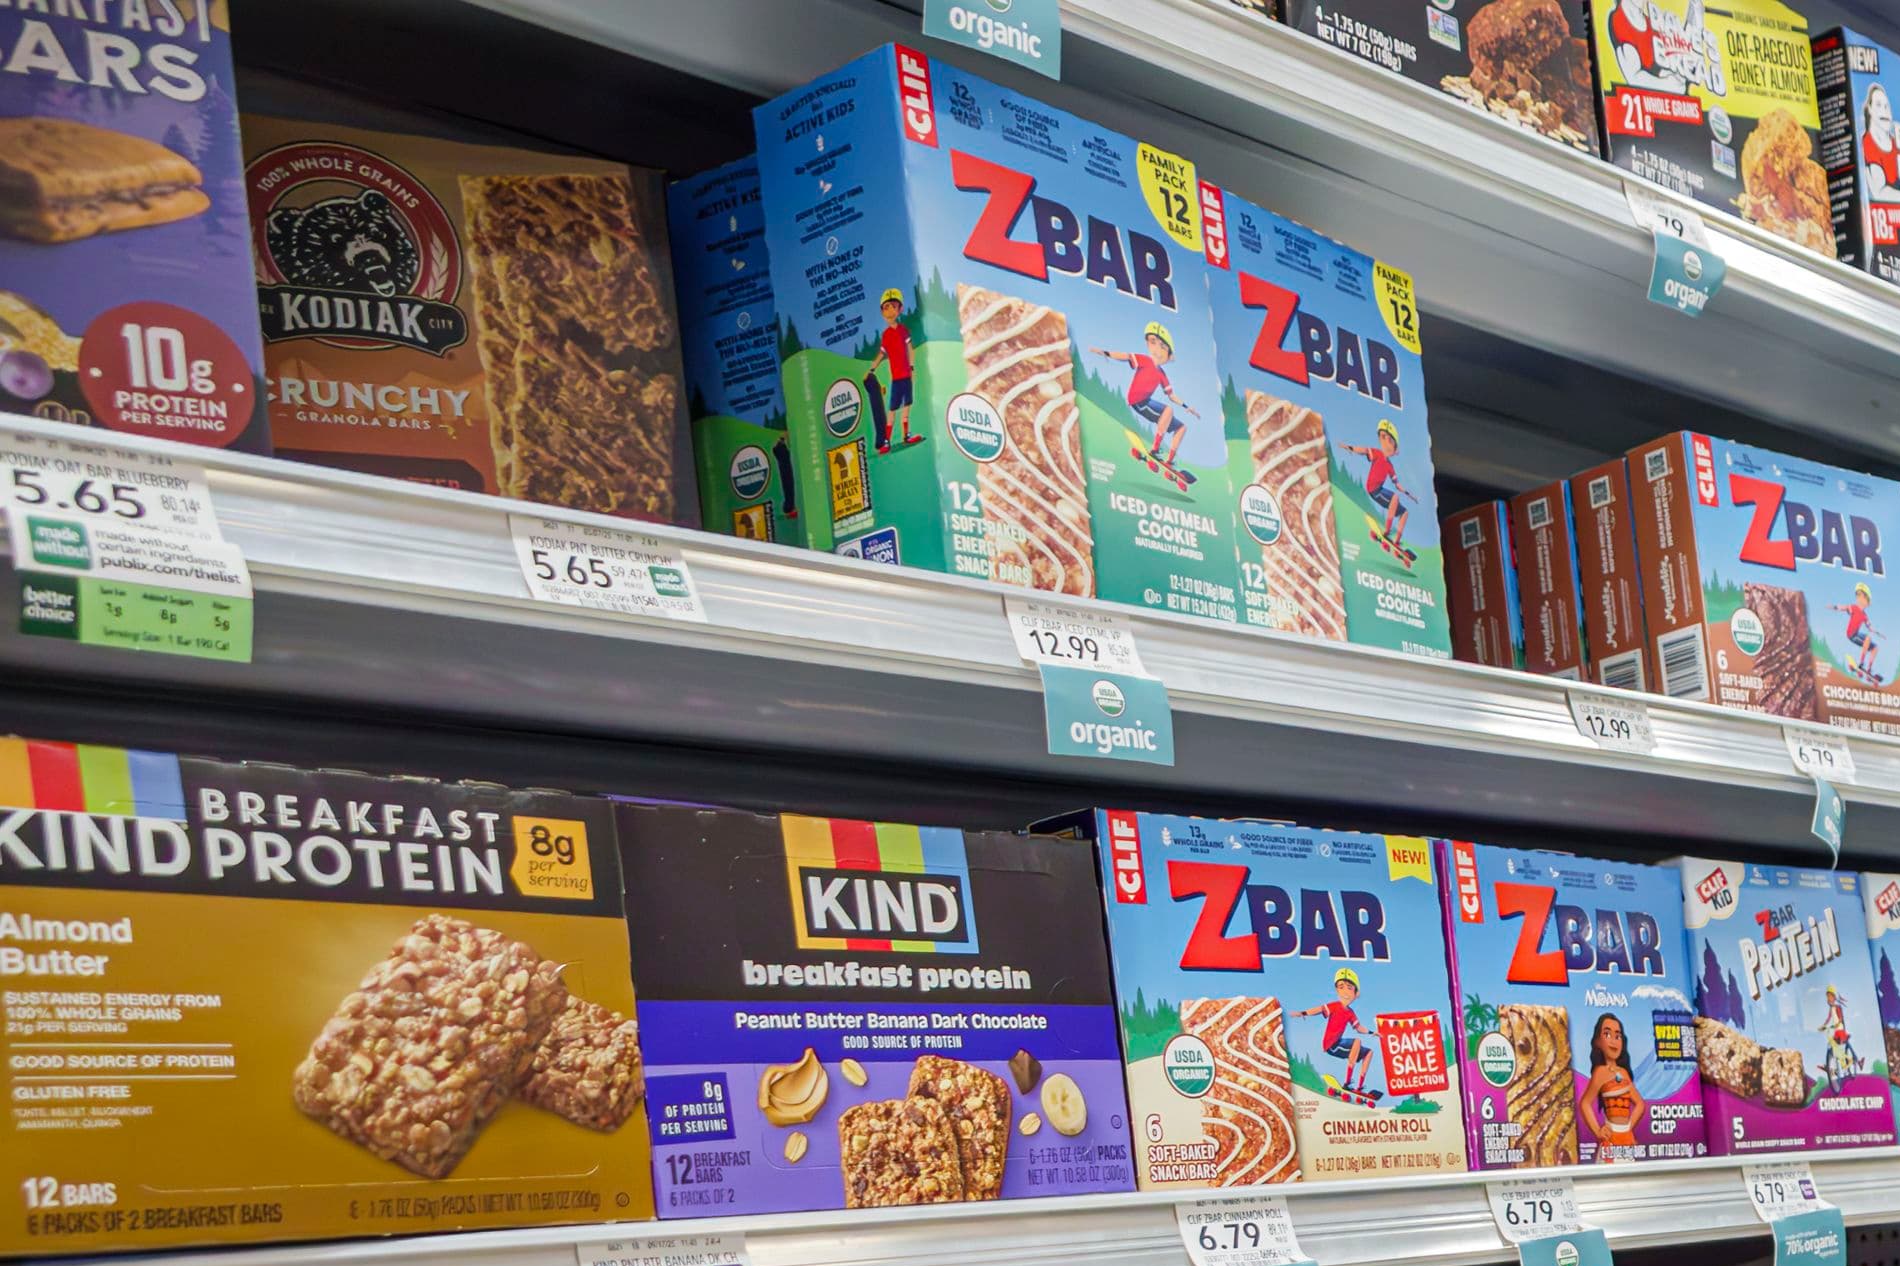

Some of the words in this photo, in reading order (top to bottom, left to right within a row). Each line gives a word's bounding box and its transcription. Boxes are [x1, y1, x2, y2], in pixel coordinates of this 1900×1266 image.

[948, 5, 1042, 59] organic
[1849, 46, 1878, 74] NEW!
[902, 51, 933, 132] CLIF
[1730, 60, 1764, 86] HONEY
[1766, 69, 1811, 98] ALMOND
[1141, 149, 1188, 176] FAMILY
[1155, 168, 1189, 191] PACK
[1160, 188, 1191, 225] 12
[1168, 222, 1194, 241] BARS
[1204, 185, 1225, 265] CLIF
[1383, 282, 1412, 302] PACK
[280, 292, 427, 344] KODIAK
[1391, 297, 1416, 331] 12
[121, 323, 216, 394] 10g
[115, 390, 228, 419] PROTEIN
[120, 409, 147, 425] PER
[152, 412, 226, 433] SERVING
[958, 409, 992, 429] USDA
[1695, 439, 1715, 502] CLIF
[10, 470, 147, 520] 5.65
[532, 548, 610, 588] 5.65
[1029, 630, 1099, 661] 12.99
[1823, 684, 1873, 704] CHOCOLATE
[1070, 719, 1157, 753] organic
[1585, 715, 1631, 741] 12.99
[1797, 746, 1834, 768] 6.79
[200, 789, 500, 843] BREAKFAST
[206, 829, 503, 895] PROTEIN
[1115, 816, 1141, 897] CLIF
[1392, 848, 1427, 866] NEW!
[529, 874, 588, 891] serving
[1457, 849, 1476, 917] CLIF
[1697, 867, 1727, 902] CLIF
[806, 875, 960, 934] KIND
[0, 913, 133, 943] Almond
[0, 948, 108, 976] Butter
[742, 960, 911, 990] breakfast
[920, 965, 1031, 992] protein
[735, 1011, 801, 1030] Peanut
[805, 1012, 863, 1029] Butter
[866, 1012, 927, 1029] Banana
[932, 1012, 967, 1029] Dark
[972, 1012, 1047, 1030] Chocolate
[1387, 1030, 1434, 1055] BAKE
[1175, 1049, 1203, 1064] USDA
[1392, 1053, 1438, 1075] SALE
[1173, 1067, 1209, 1081] ORGANIC
[1389, 1073, 1445, 1088] COLLECTION
[704, 1080, 723, 1101] 8g
[666, 1105, 678, 1117] OF
[681, 1103, 725, 1117] PROTEIN
[1820, 1098, 1859, 1113] CHOCOLATE
[1862, 1097, 1884, 1109] CHIP
[661, 1121, 681, 1135] PER
[683, 1118, 728, 1133] SERVING
[1147, 1114, 1163, 1141] 6
[1322, 1120, 1400, 1135] CINNAMON
[1403, 1119, 1432, 1134] ROLL
[1650, 1120, 1676, 1134] CHIP
[1148, 1144, 1215, 1162] SOFT-BAKED
[666, 1155, 692, 1184] 12
[694, 1151, 751, 1169] BREAKFAST
[695, 1167, 723, 1183] BARS
[1150, 1166, 1187, 1181] SNACK
[1189, 1164, 1217, 1180] BARS
[23, 1178, 59, 1207] 12
[63, 1183, 116, 1205] BARS
[1755, 1185, 1784, 1203] 6.79
[1506, 1201, 1553, 1226] 6.79
[1200, 1222, 1260, 1251] 6.79
